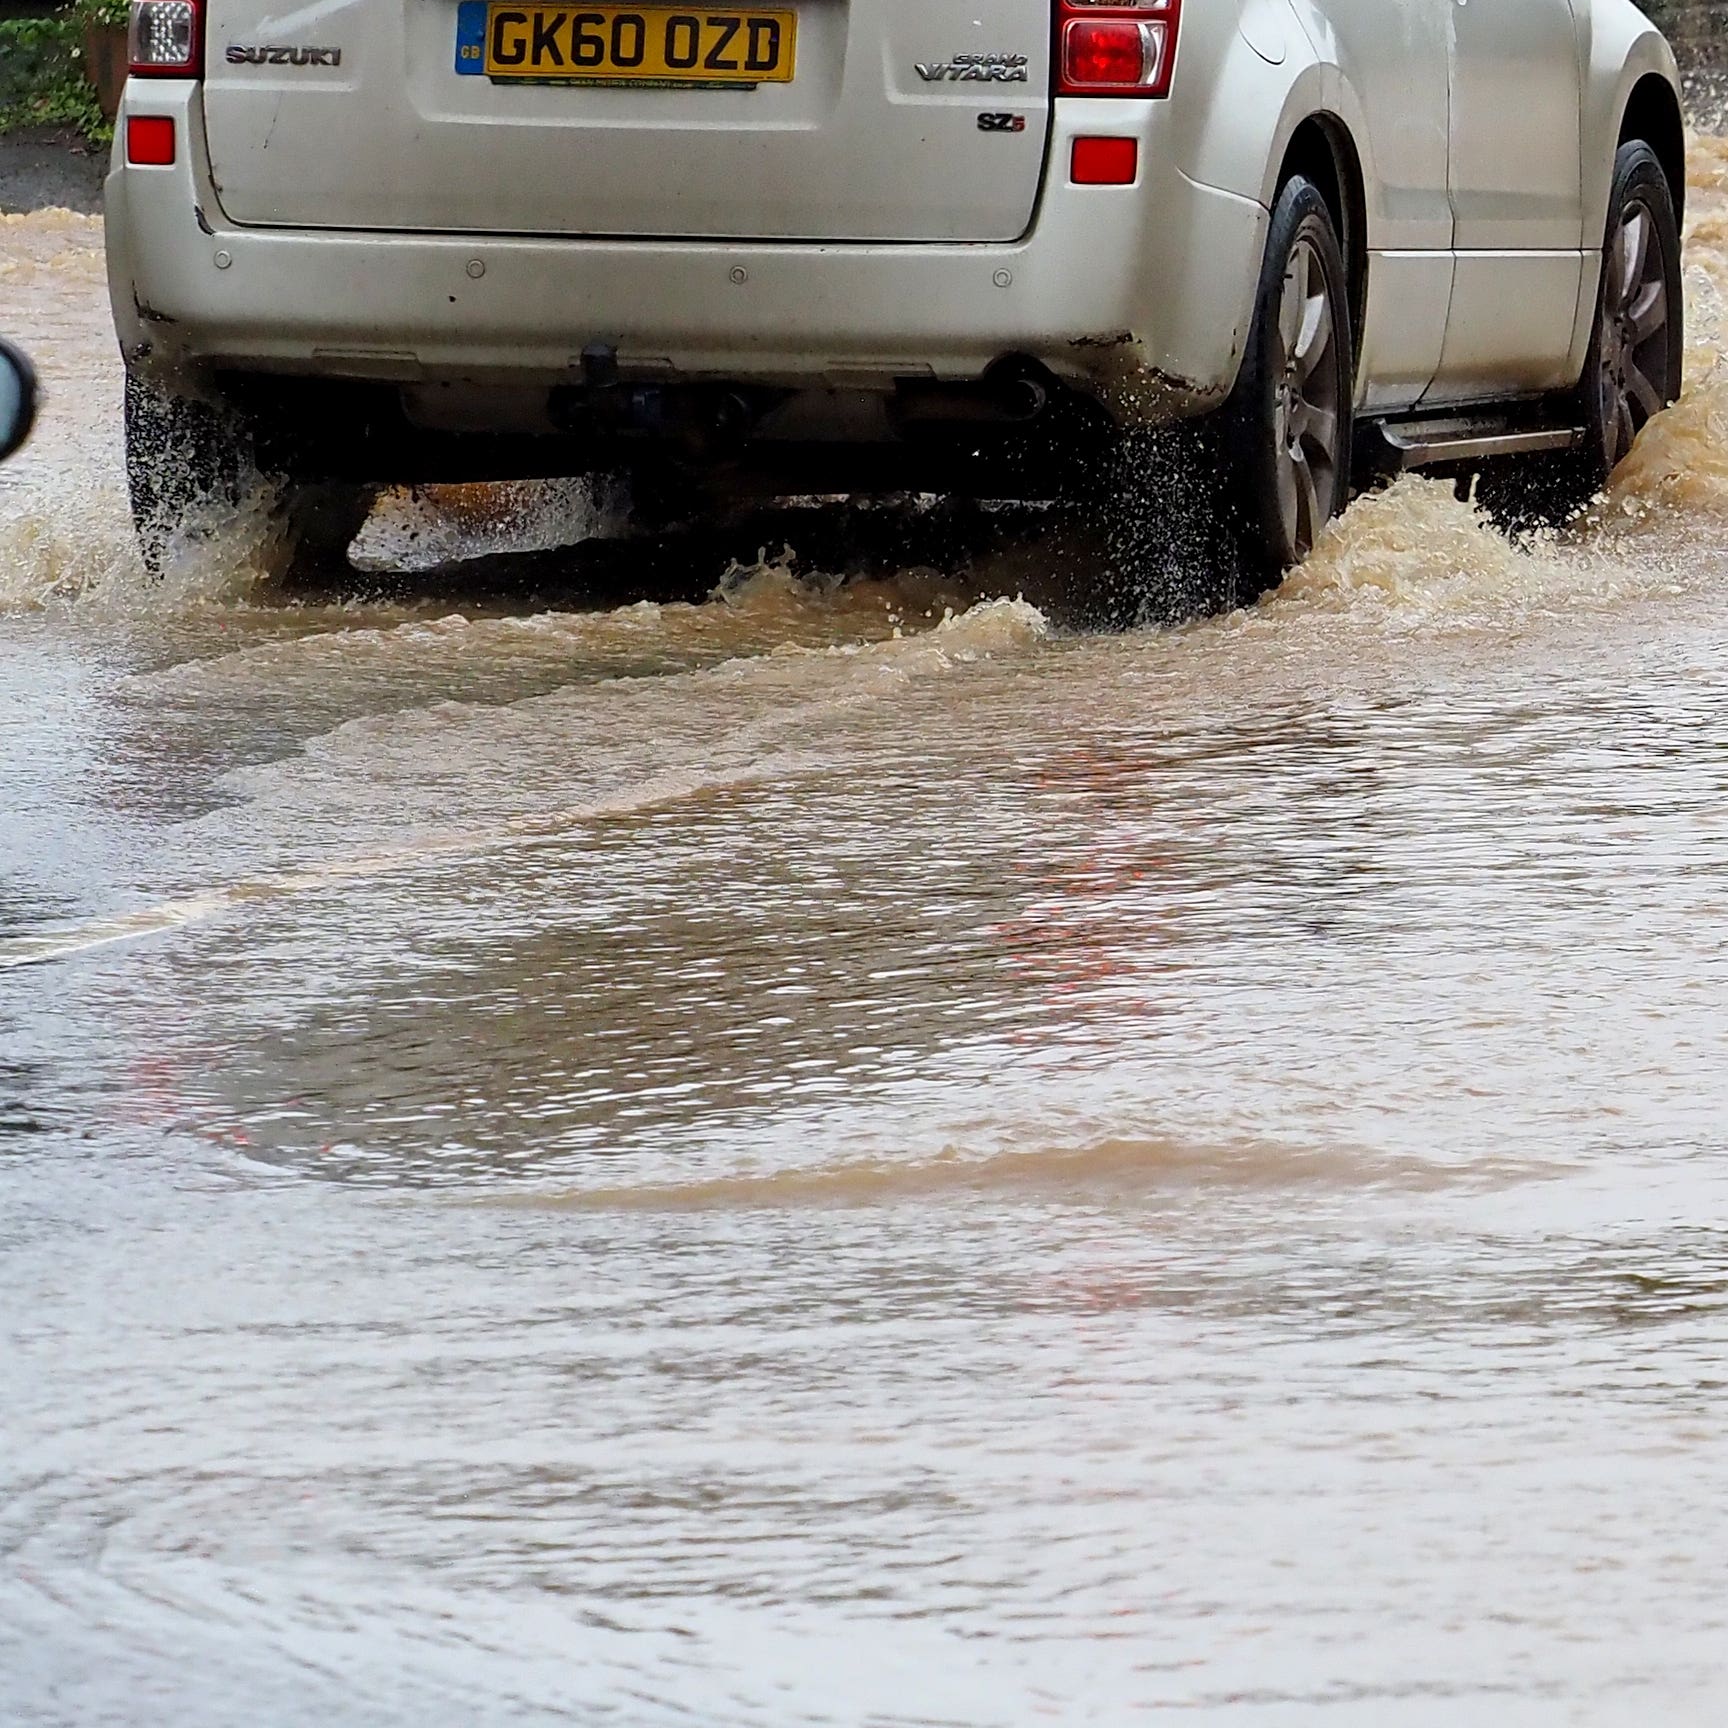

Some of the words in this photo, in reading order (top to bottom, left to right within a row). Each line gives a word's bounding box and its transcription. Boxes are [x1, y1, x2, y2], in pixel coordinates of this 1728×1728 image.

[492, 12, 646, 68] GK60
[664, 15, 781, 72] OZD
[225, 44, 342, 66] SUZUKI
[460, 45, 481, 60] GB
[952, 52, 1028, 67] GRAND
[914, 63, 1028, 82] VITARA
